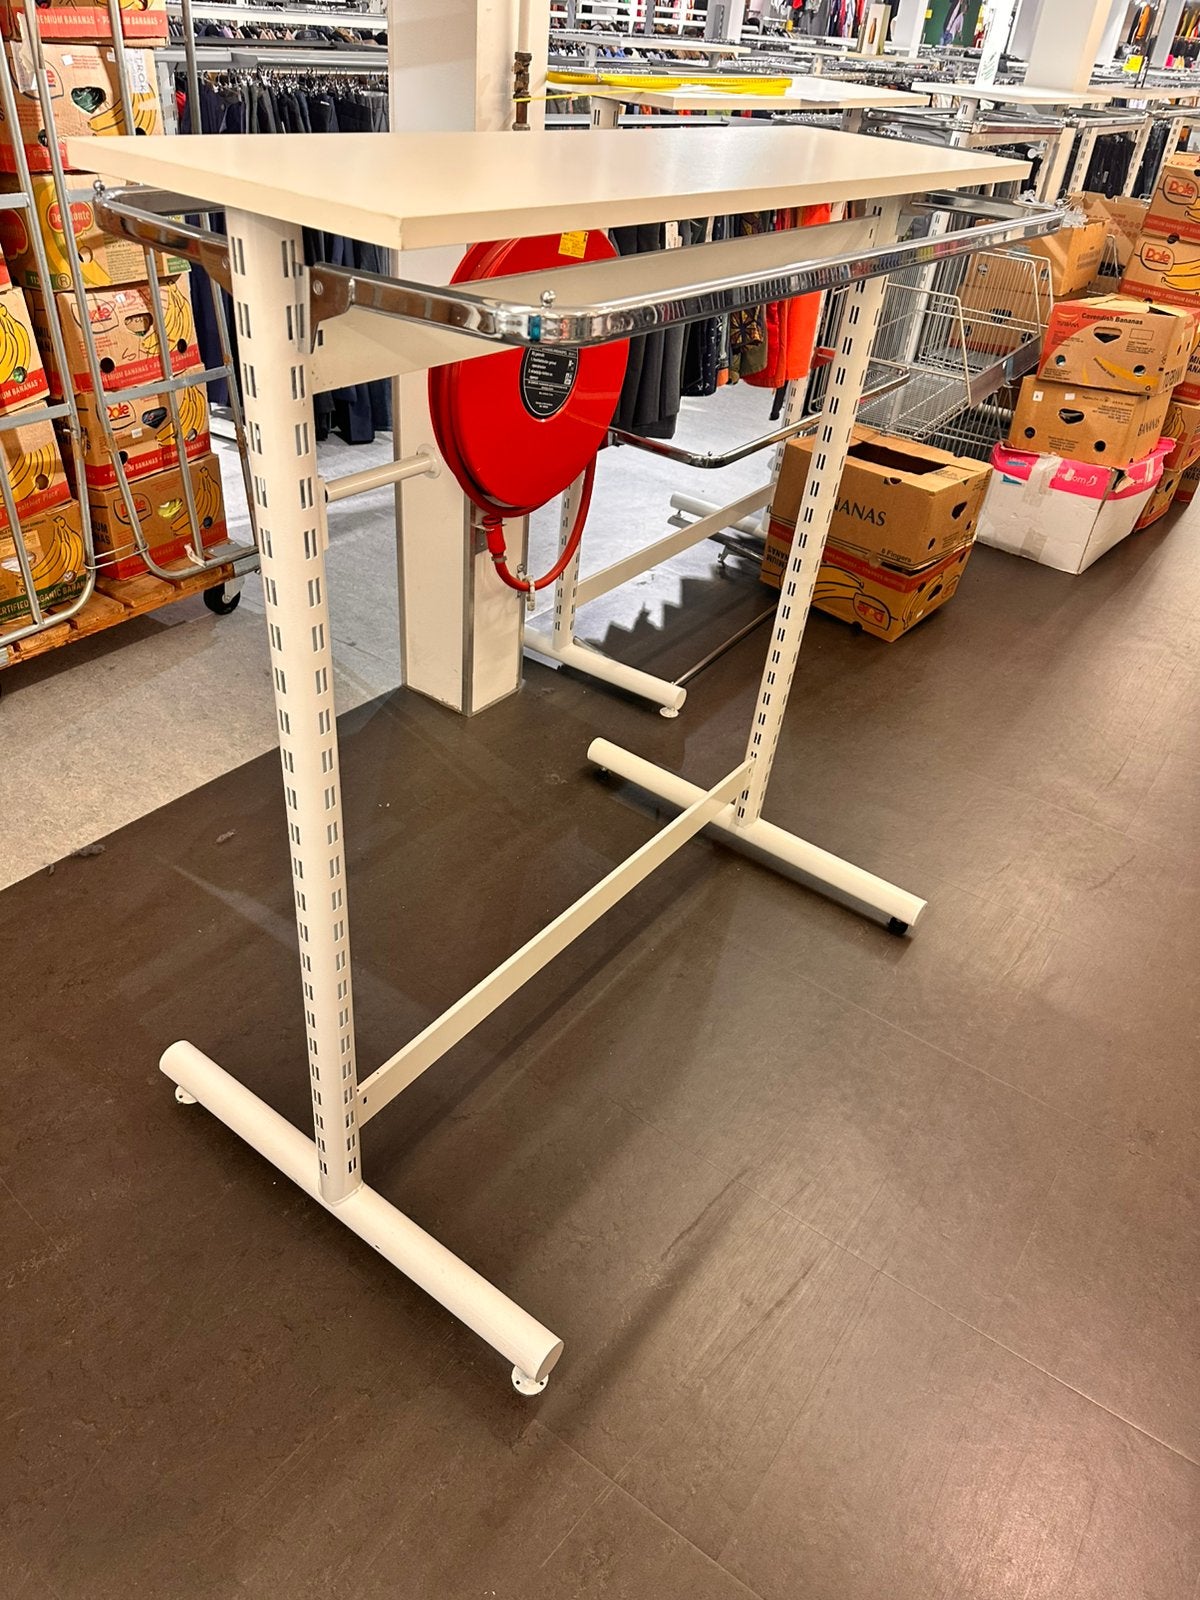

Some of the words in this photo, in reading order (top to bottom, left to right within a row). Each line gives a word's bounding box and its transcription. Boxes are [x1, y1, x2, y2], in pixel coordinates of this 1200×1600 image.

[63, 15, 95, 25] BANANAS
[1169, 180, 1195, 195] Dole
[1145, 247, 1171, 262] Dole
[1081, 312, 1114, 322] Cavendish
[1114, 316, 1143, 325] Bananas
[12, 379, 38, 397] BANANAS
[135, 456, 158, 470] BANANAS
[857, 602, 884, 623] Dole
